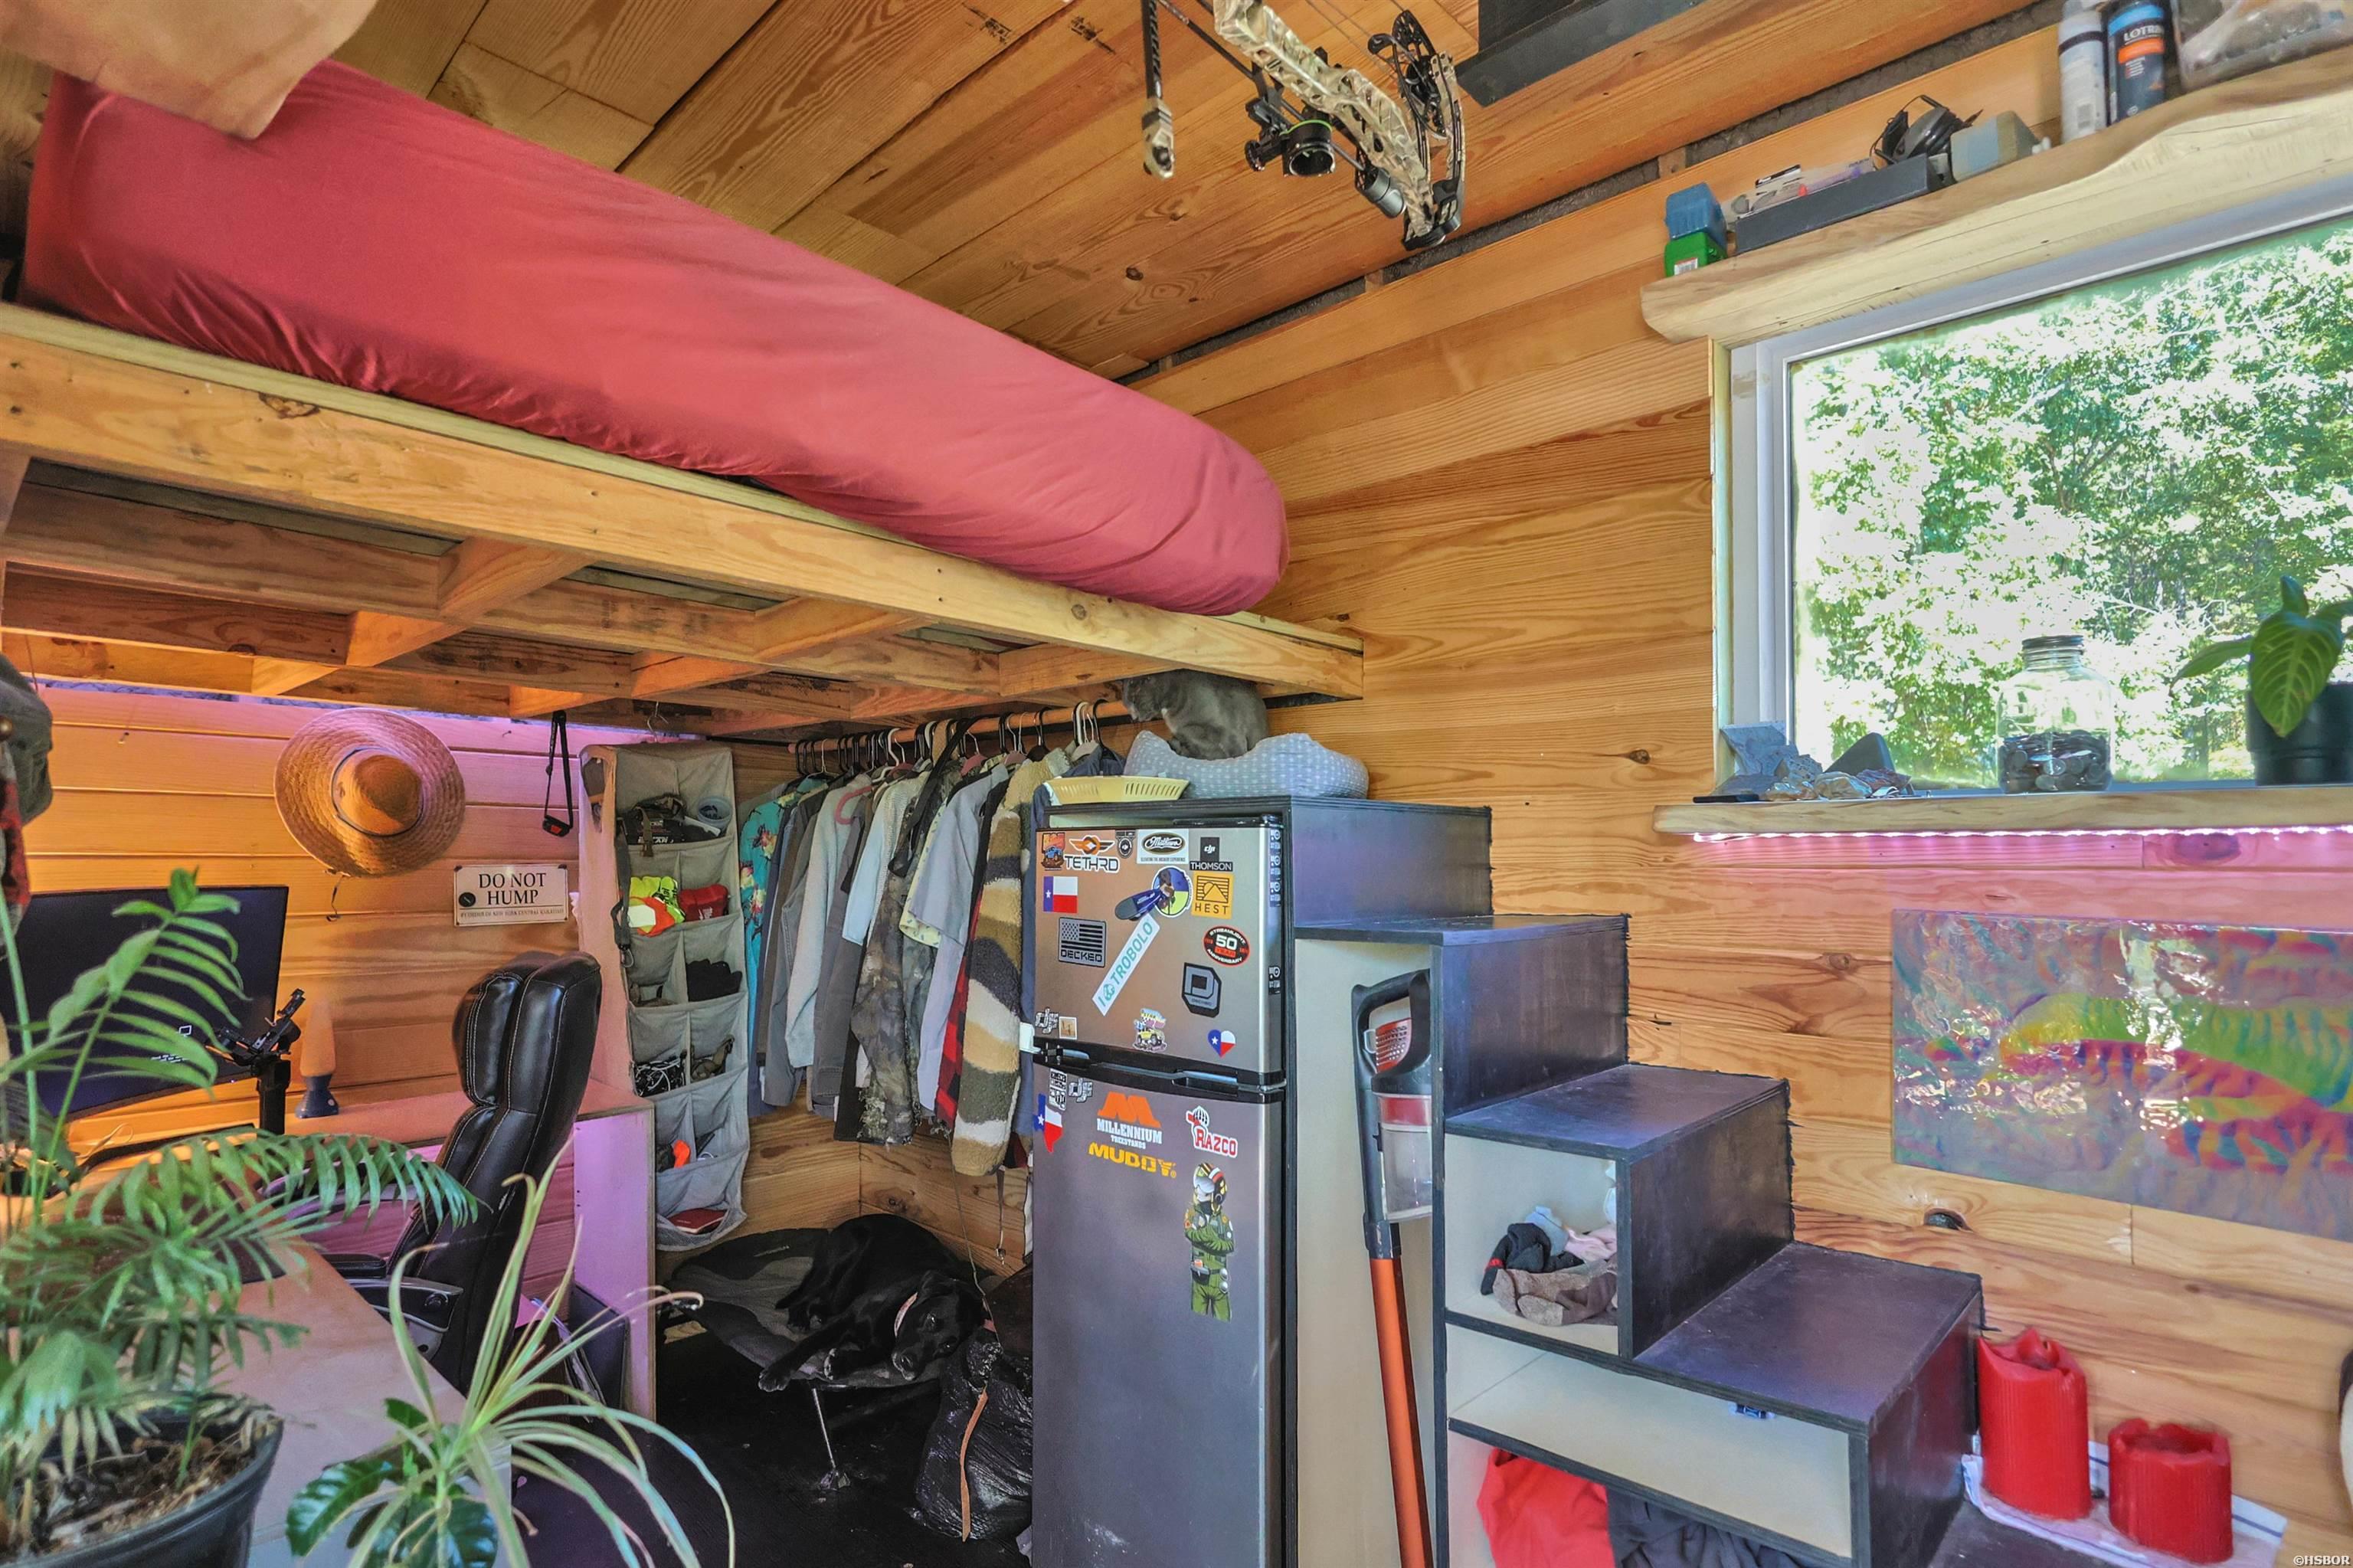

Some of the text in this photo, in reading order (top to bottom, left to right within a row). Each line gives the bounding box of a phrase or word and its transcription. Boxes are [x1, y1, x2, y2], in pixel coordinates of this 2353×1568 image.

[1064, 855, 1119, 872] TETHRD
[1190, 862, 1232, 871] THOMSON
[479, 872, 546, 889] DO NOT
[487, 889, 538, 905] HUMP
[1195, 902, 1229, 915] HEST
[1216, 934, 1237, 951] 50
[1060, 949, 1103, 962] DECKED
[1111, 921, 1154, 985] TROBOLO
[1096, 1118, 1163, 1144] MILLENNIUM
[1111, 1134, 1147, 1150] TREESTANDS
[1195, 1128, 1237, 1156] RAZCO
[1088, 1141, 1176, 1177] MUDDY
